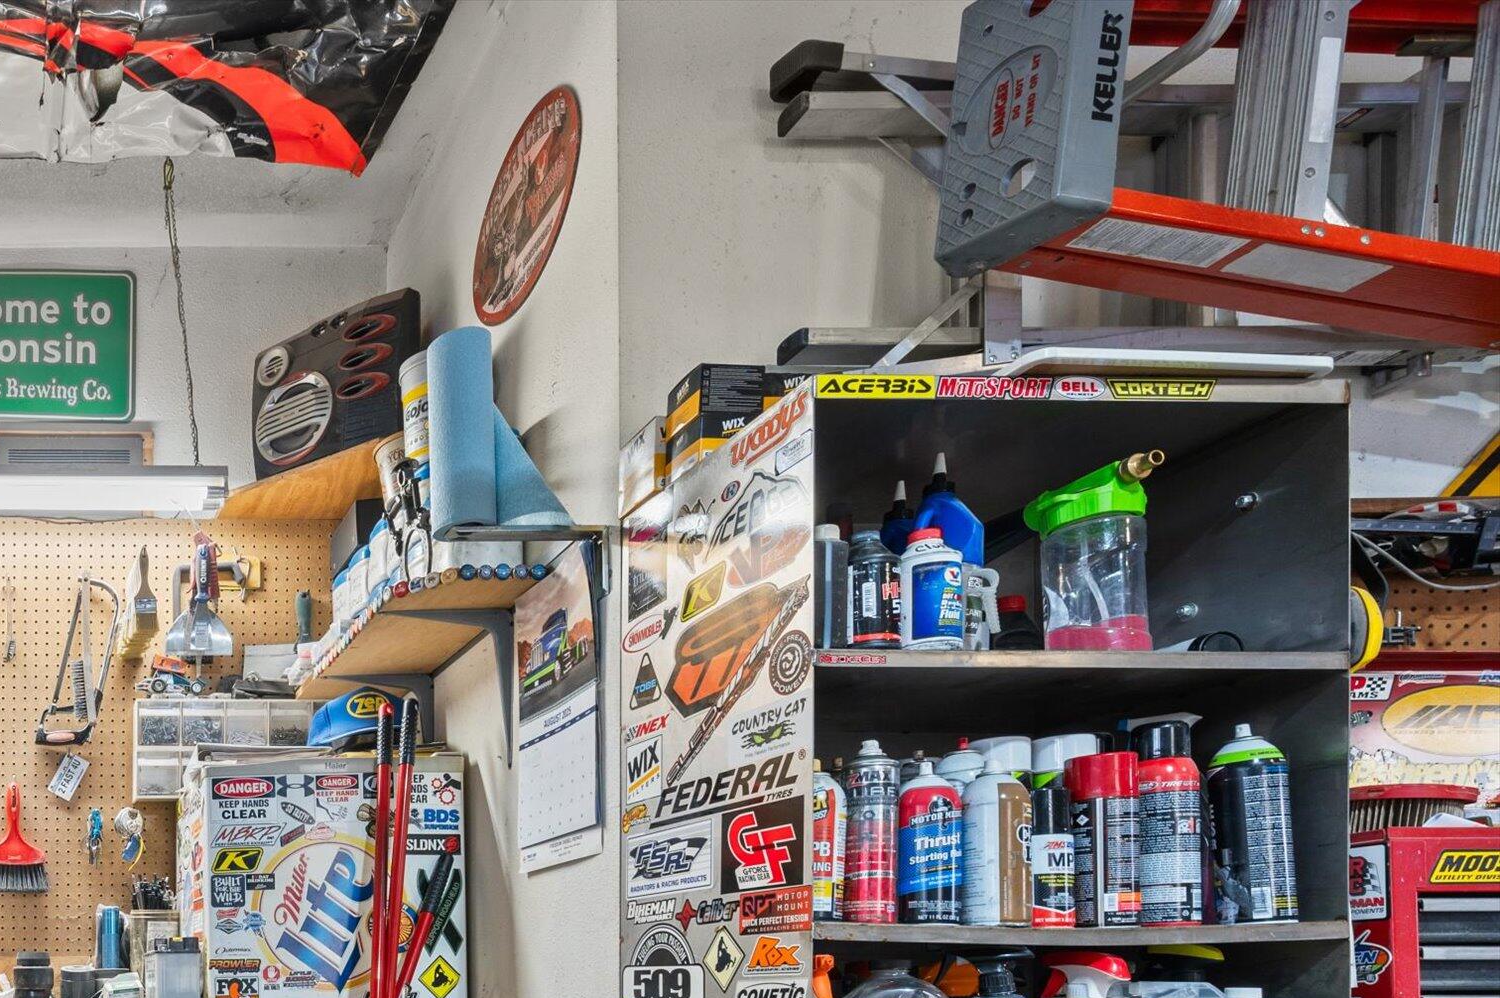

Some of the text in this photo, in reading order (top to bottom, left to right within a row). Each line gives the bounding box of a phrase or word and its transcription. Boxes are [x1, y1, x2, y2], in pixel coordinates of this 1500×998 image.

[1092, 11, 1124, 123] KELLER
[73, 293, 111, 325] to
[6, 377, 77, 406] Brewing
[82, 379, 112, 401] Co.
[819, 378, 933, 394] ACERBIS
[1060, 380, 1099, 393] BELL
[1110, 380, 1212, 397] CORTECH
[721, 416, 745, 430] WIX
[628, 619, 663, 648] SNOWMOBILER
[634, 679, 657, 695] TOBE
[773, 672, 806, 695] POWER
[731, 697, 807, 735] COUNTRY CAT
[627, 739, 660, 783] WIX
[219, 782, 268, 794] DANGER
[322, 777, 352, 786] DANGER
[654, 751, 799, 819] FEDERAL
[766, 788, 794, 802] TYRES
[218, 799, 269, 808] KEEP HANDS
[221, 809, 267, 820] CLEAR
[423, 809, 460, 823] BDS
[911, 812, 941, 826] MOTOR
[215, 825, 282, 842] MBRP
[406, 840, 447, 852] SLDNX
[914, 833, 961, 851] Thrust
[635, 841, 692, 873] FSR
[909, 850, 948, 865] Starting
[742, 866, 769, 875] G-FORCE
[1434, 874, 1472, 882] UTILITY
[212, 875, 242, 887] BUILT
[661, 874, 708, 888] RACING PRODUCTS
[738, 874, 756, 884] RACING
[273, 852, 309, 926] Miller
[627, 900, 675, 919] BIKEMAN
[696, 900, 738, 925] Caliber
[777, 902, 809, 911] MOUNT
[758, 916, 786, 926] PERFECT
[209, 959, 261, 969] PROWLER
[216, 978, 258, 995] FOX
